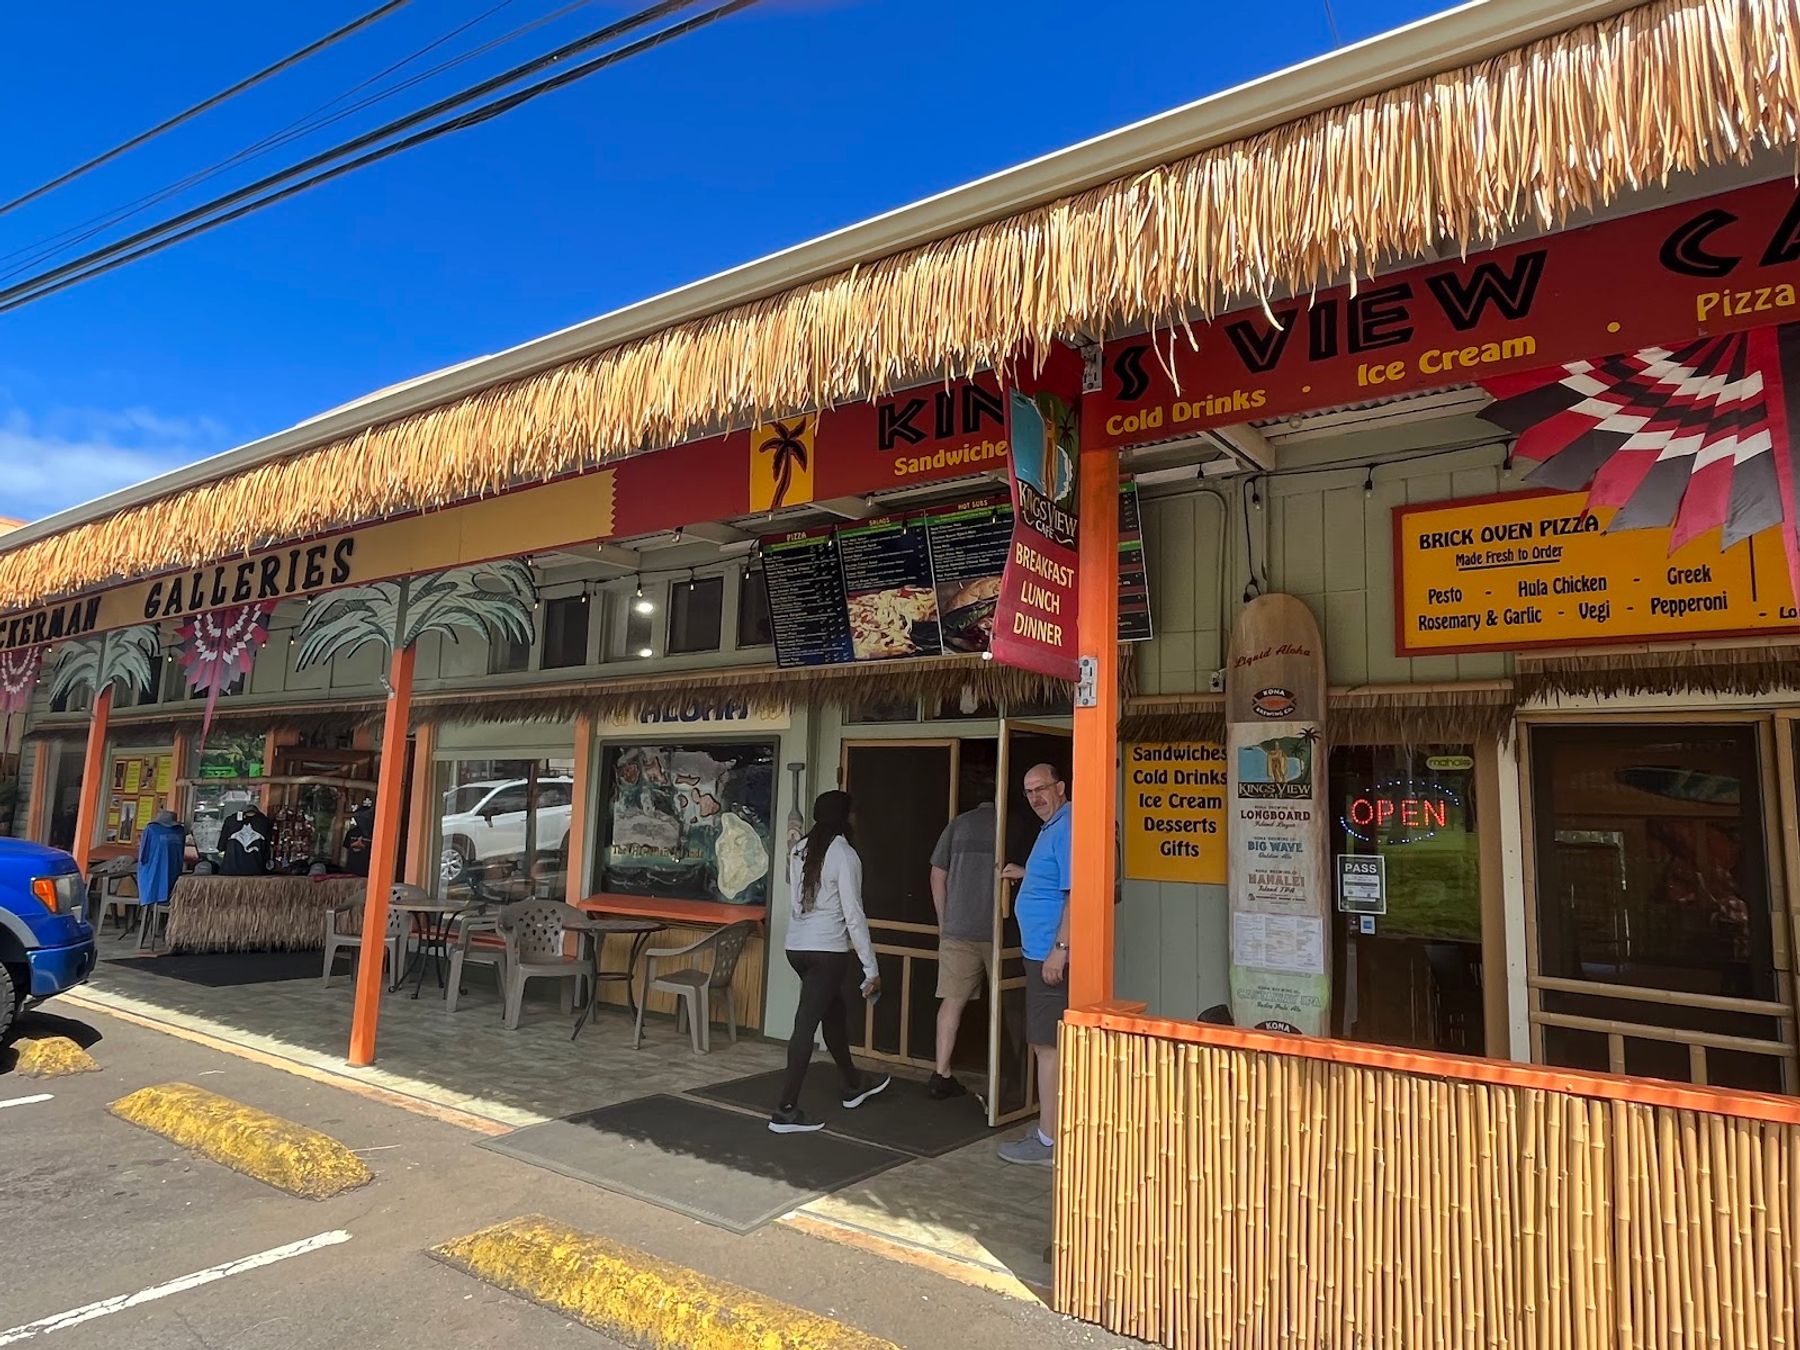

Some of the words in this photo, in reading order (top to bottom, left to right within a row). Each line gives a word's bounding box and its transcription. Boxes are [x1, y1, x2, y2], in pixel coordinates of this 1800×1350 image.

[1223, 249, 1548, 374] VIEW
[1696, 283, 1796, 322] Pizza
[1357, 360, 1406, 387] Ice
[1418, 335, 1537, 375] Cream
[878, 384, 1004, 450] KIN
[1105, 406, 1163, 437] Cold
[1171, 388, 1267, 424] Drinks
[894, 439, 1008, 476] Sandwiche
[785, 530, 807, 542] PIZZA
[1419, 527, 1474, 550] BRICK
[1480, 521, 1534, 544] OVEN
[1539, 513, 1600, 538] PIZZA
[1015, 541, 1075, 589] BREAKFAST
[1455, 551, 1483, 567] Made
[1485, 548, 1514, 565] Fresh
[1518, 547, 1529, 561] to
[1532, 545, 1564, 559] Order
[143, 537, 355, 619] GALLERIES
[1428, 586, 1463, 605] Pesto
[1518, 578, 1549, 598] Hula
[1552, 574, 1608, 595] Chicken
[1667, 563, 1712, 585] Greek
[1020, 579, 1061, 616] LUNCH
[1418, 612, 1482, 631] Rosemary
[1485, 608, 1498, 627] &
[1503, 606, 1543, 625] Garlic
[1578, 599, 1611, 623] Vegi
[1650, 589, 1729, 618] Pepperoni
[1779, 606, 1798, 619] Lo
[1013, 611, 1063, 647] DINNER
[1233, 646, 1272, 668] Liquid
[1275, 643, 1311, 656] Aloha
[1262, 688, 1286, 697] KONA
[1132, 744, 1228, 762] Sandwiches
[1132, 769, 1168, 785] Cold
[1173, 769, 1228, 785] Drinks
[1139, 793, 1162, 808] Ice
[1168, 793, 1222, 809] Cream
[1351, 798, 1447, 827] OPEN
[1143, 816, 1217, 834] Desserts
[1240, 810, 1311, 821] LONGBOARD
[1160, 840, 1200, 857] Gifts
[1247, 840, 1267, 852] BIG
[1269, 841, 1304, 853] WAVE
[1345, 862, 1378, 874] PASS
[1264, 1021, 1291, 1033] KONA
